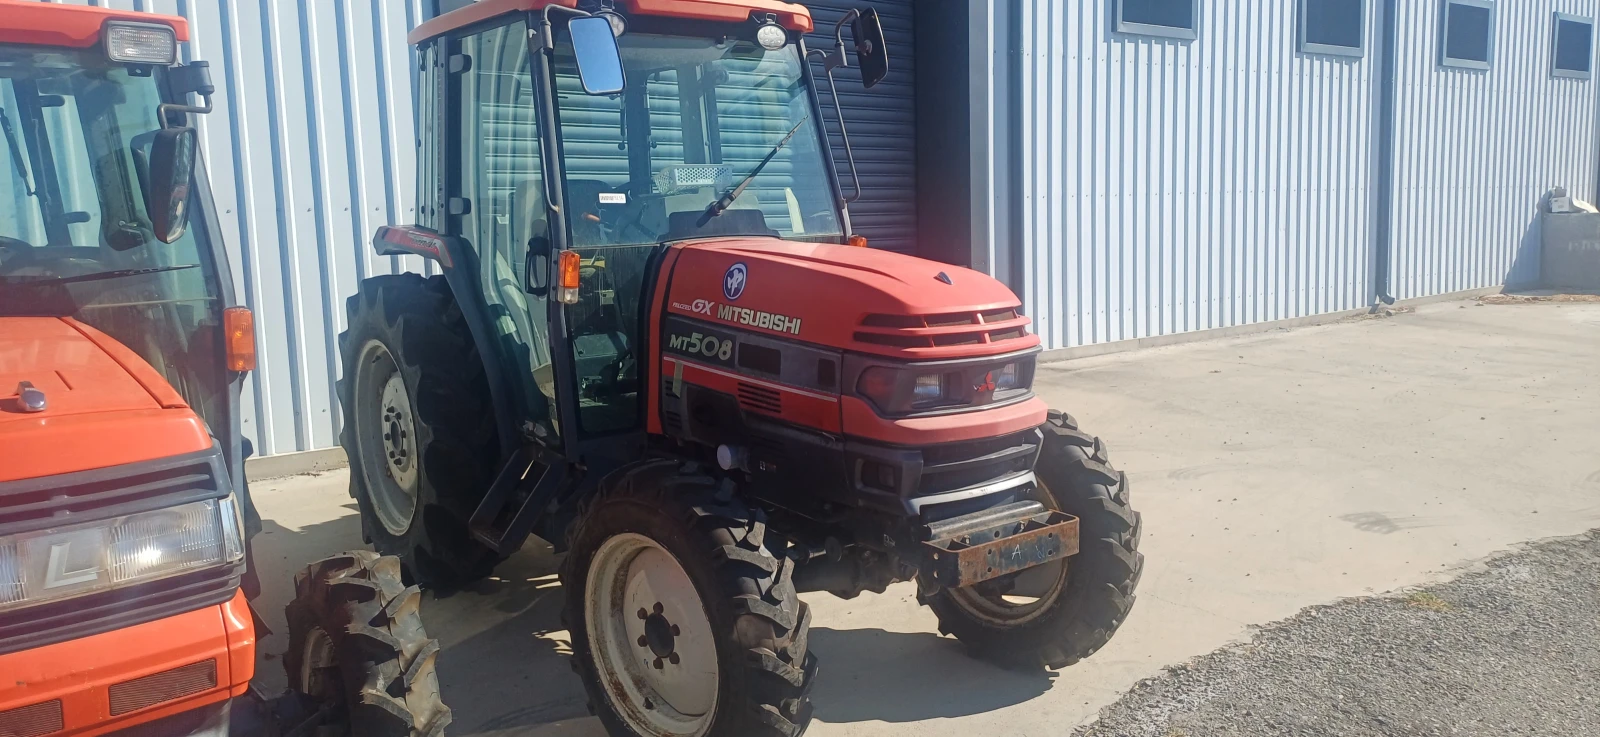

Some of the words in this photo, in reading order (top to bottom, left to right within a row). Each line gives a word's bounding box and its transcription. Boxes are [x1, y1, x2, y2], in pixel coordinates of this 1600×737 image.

[692, 299, 715, 315] GX
[717, 304, 801, 334] MITSUBISHI
[669, 333, 732, 360] MT508
